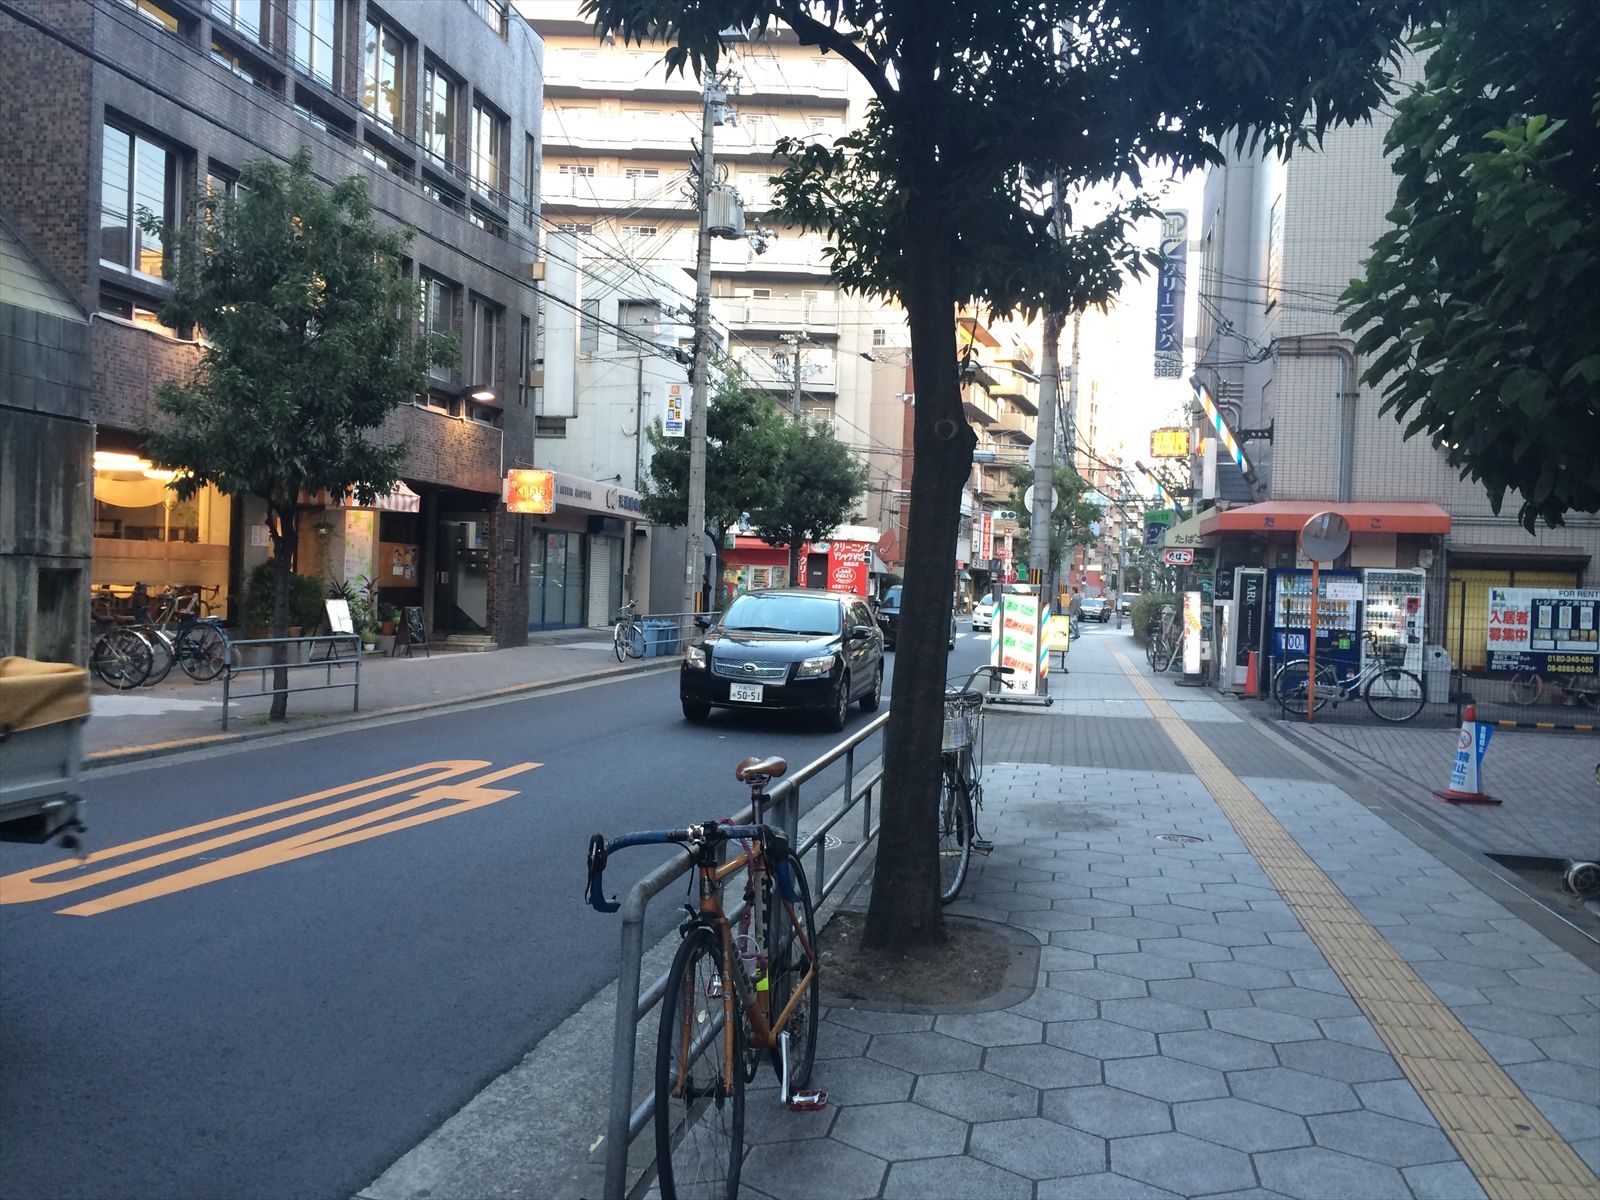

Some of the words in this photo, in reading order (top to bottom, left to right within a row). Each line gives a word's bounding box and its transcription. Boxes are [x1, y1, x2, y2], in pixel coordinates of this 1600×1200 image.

[1160, 260, 1178, 349] クリーニング
[1153, 368, 1181, 377] 3928
[1174, 534, 1204, 544] たばこ
[833, 542, 870, 553] クリーニング
[1168, 552, 1189, 561] たばこ
[1246, 579, 1257, 606] LARK
[1490, 611, 1529, 625] 入居者
[1489, 627, 1528, 642] 募集中
[737, 690, 760, 702] 50-51
